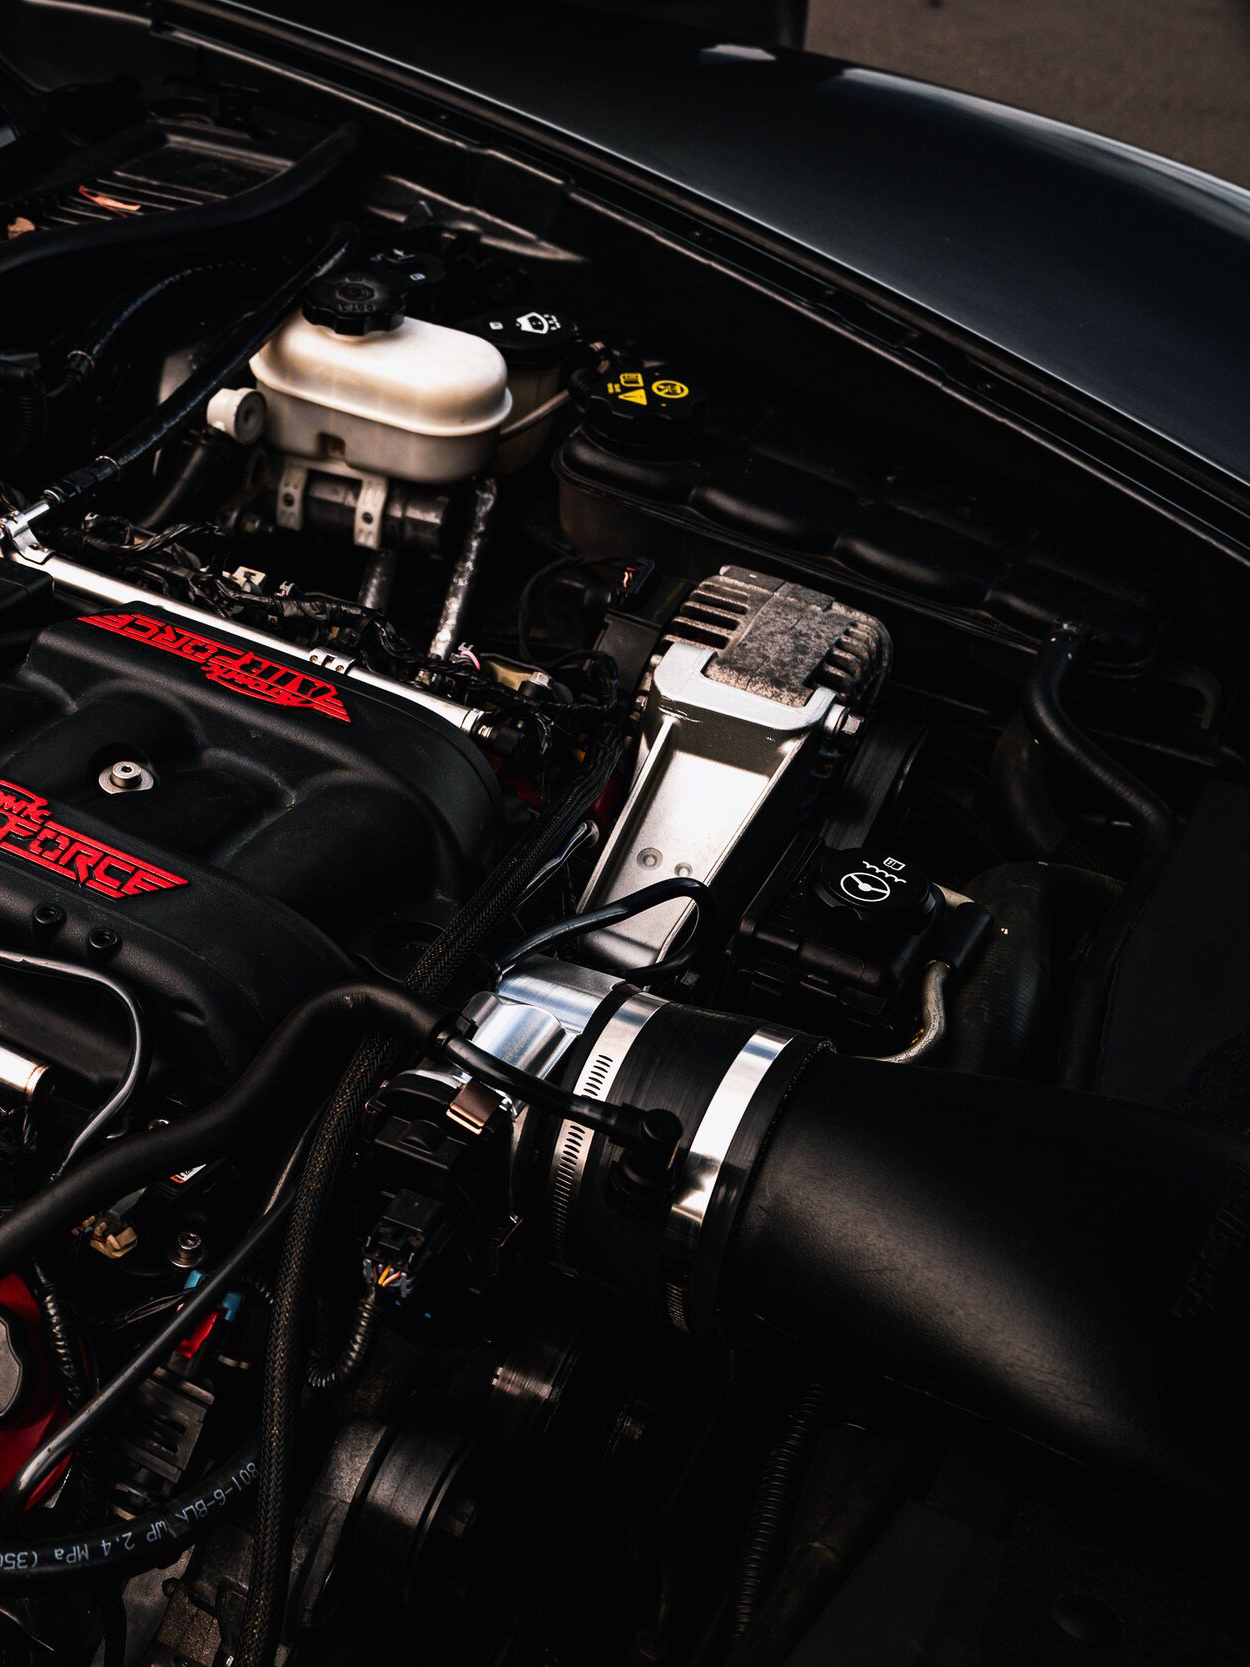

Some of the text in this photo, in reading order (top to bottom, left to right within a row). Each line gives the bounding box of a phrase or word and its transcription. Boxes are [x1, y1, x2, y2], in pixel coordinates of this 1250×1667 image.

[100, 1531, 135, 1556] 2.4
[146, 1519, 169, 1544] WP
[54, 1543, 89, 1565] MPa
